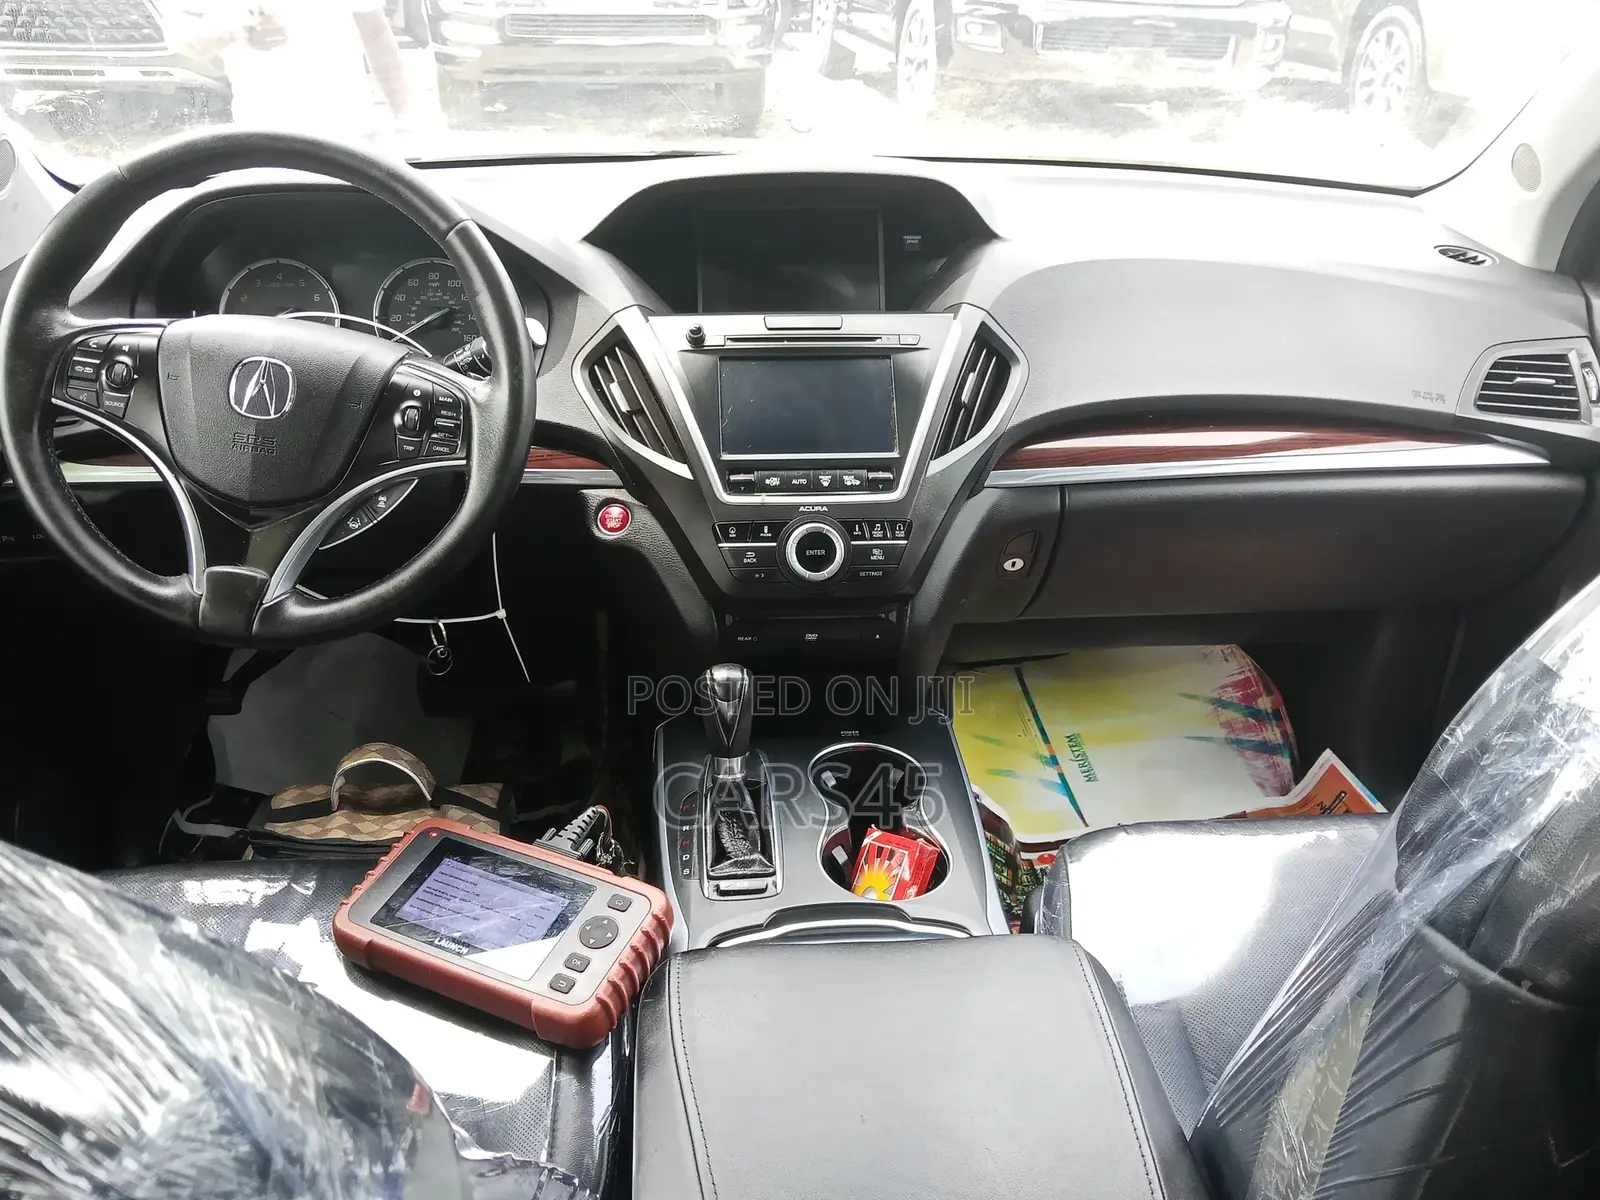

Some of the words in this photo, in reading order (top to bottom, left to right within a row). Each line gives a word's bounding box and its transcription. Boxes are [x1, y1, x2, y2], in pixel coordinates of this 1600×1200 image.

[428, 272, 440, 280] 80
[408, 279, 419, 287] 60
[447, 279, 461, 287] 100
[394, 294, 406, 302] 40
[390, 314, 402, 322] 20
[104, 400, 125, 408] SOURCE
[432, 445, 450, 453] CANCEL
[433, 936, 470, 956] LAUNCH
[571, 958, 583, 967] OK
